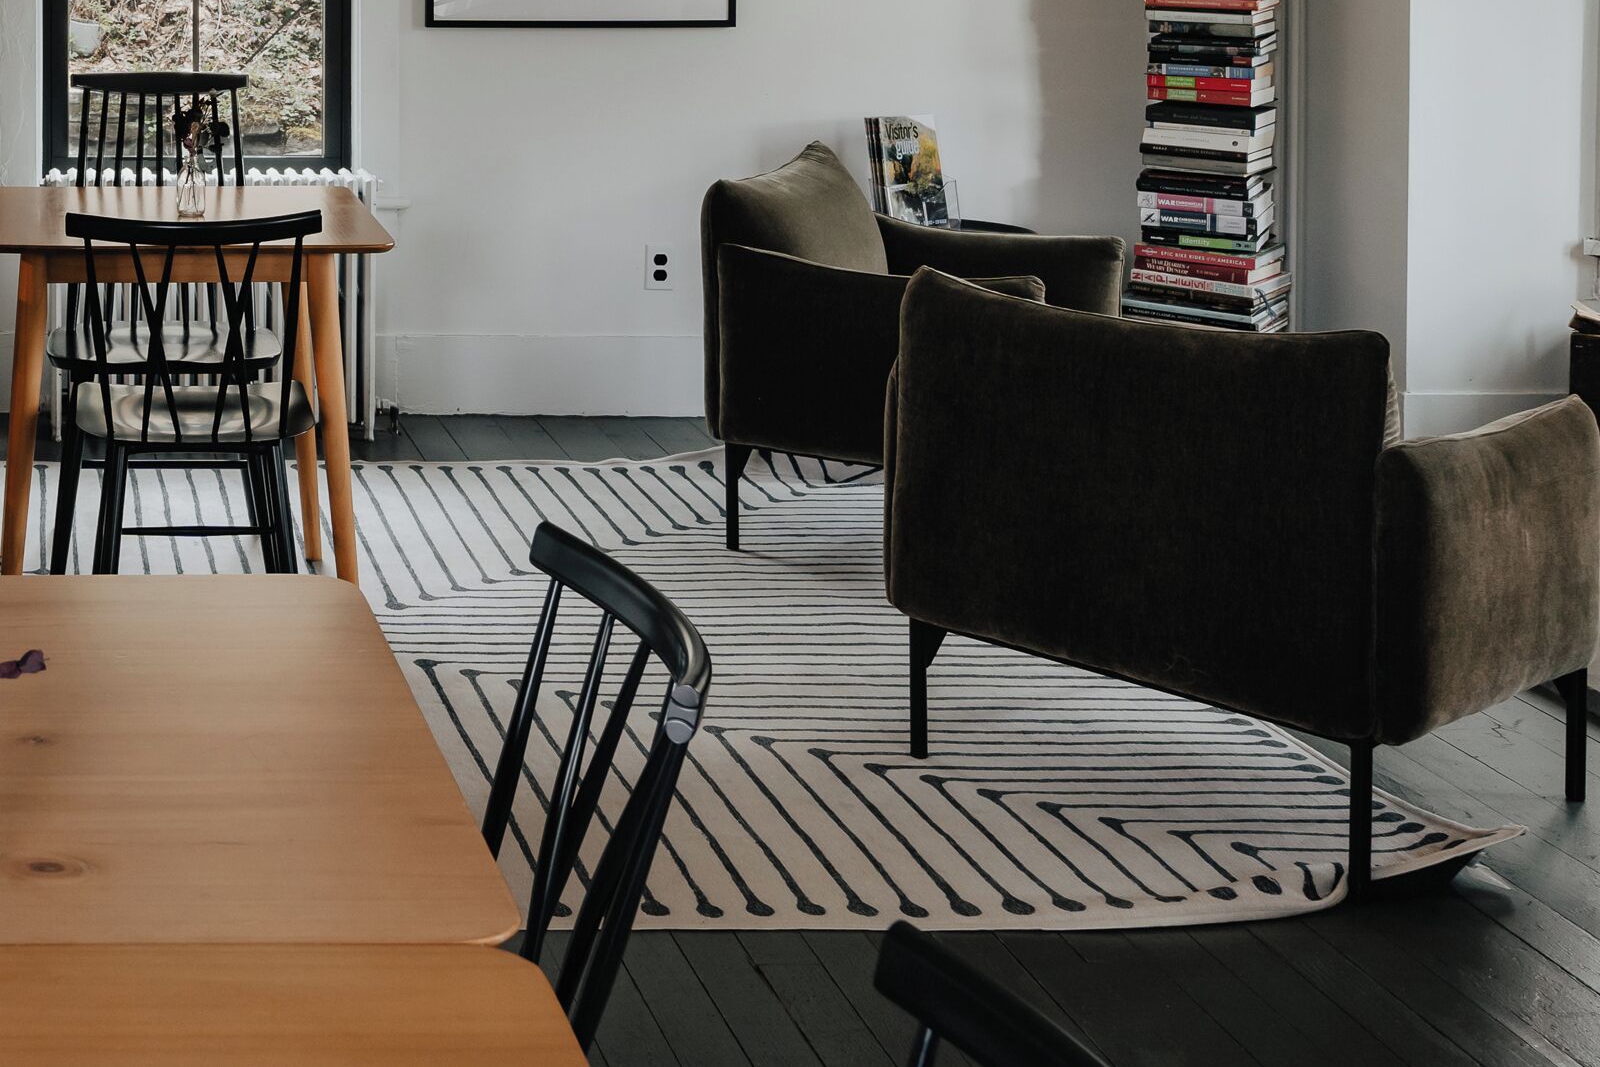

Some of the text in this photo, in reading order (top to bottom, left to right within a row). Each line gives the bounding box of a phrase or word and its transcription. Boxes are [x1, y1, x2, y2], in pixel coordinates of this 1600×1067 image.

[884, 122, 919, 140] Visitor's
[895, 139, 920, 160] guide
[1181, 237, 1210, 246] Identity
[1146, 263, 1189, 275] WEARY DUNLOP
[1217, 258, 1246, 266] AMERICAS
[1132, 272, 1205, 290] NAPLES
